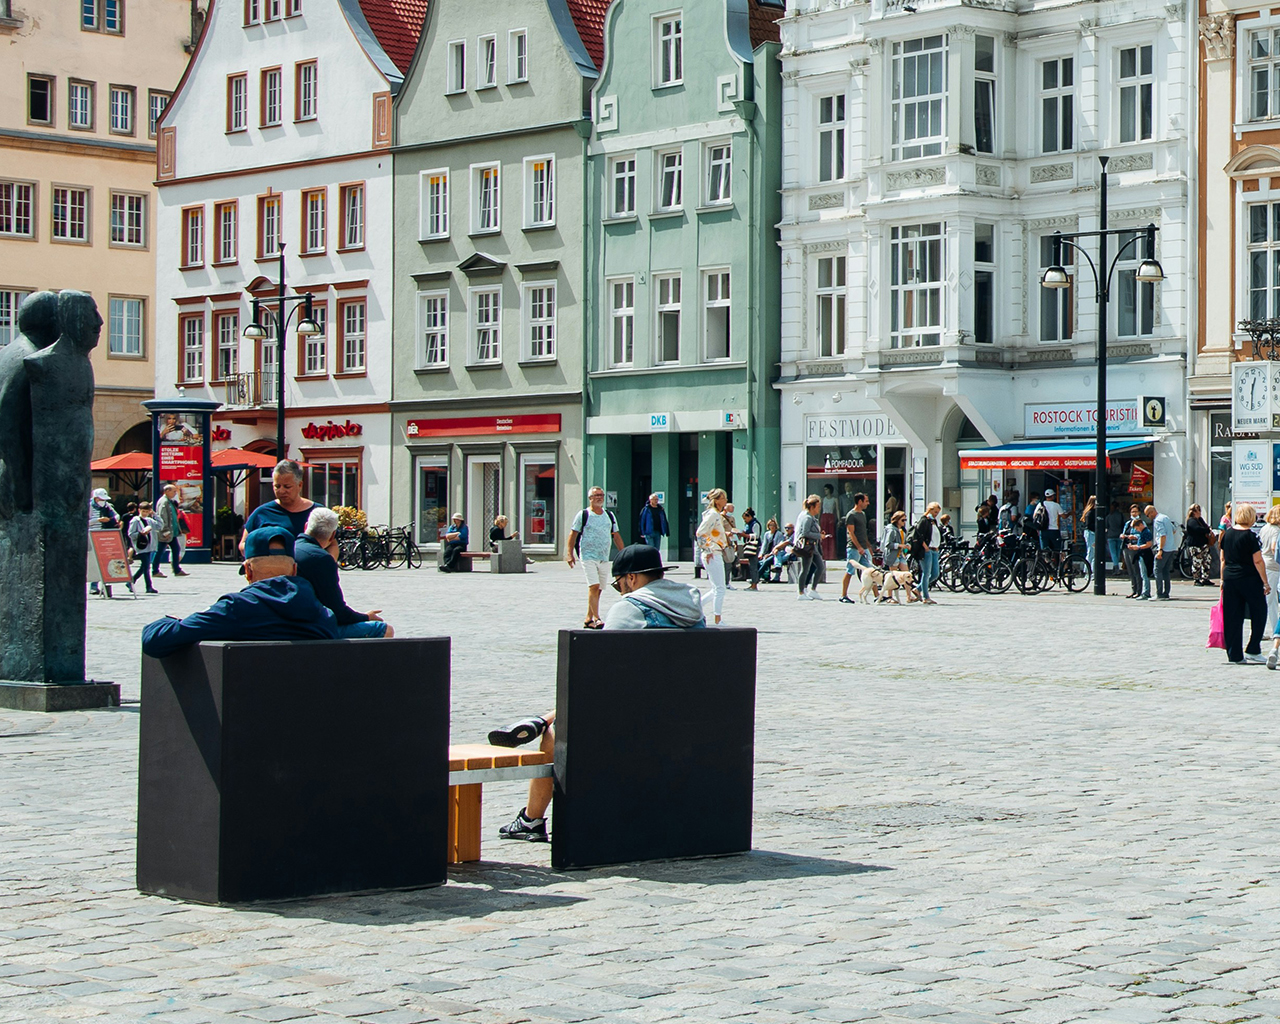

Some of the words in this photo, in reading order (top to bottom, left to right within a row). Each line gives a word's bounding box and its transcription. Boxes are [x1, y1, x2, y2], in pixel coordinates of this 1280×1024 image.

[651, 415, 666, 426] DKB
[1033, 410, 1083, 424] ROSTOCK
[1086, 408, 1137, 422] TORISTI
[809, 418, 897, 438] FESTMODE
[831, 459, 864, 468] POMPADOUR
